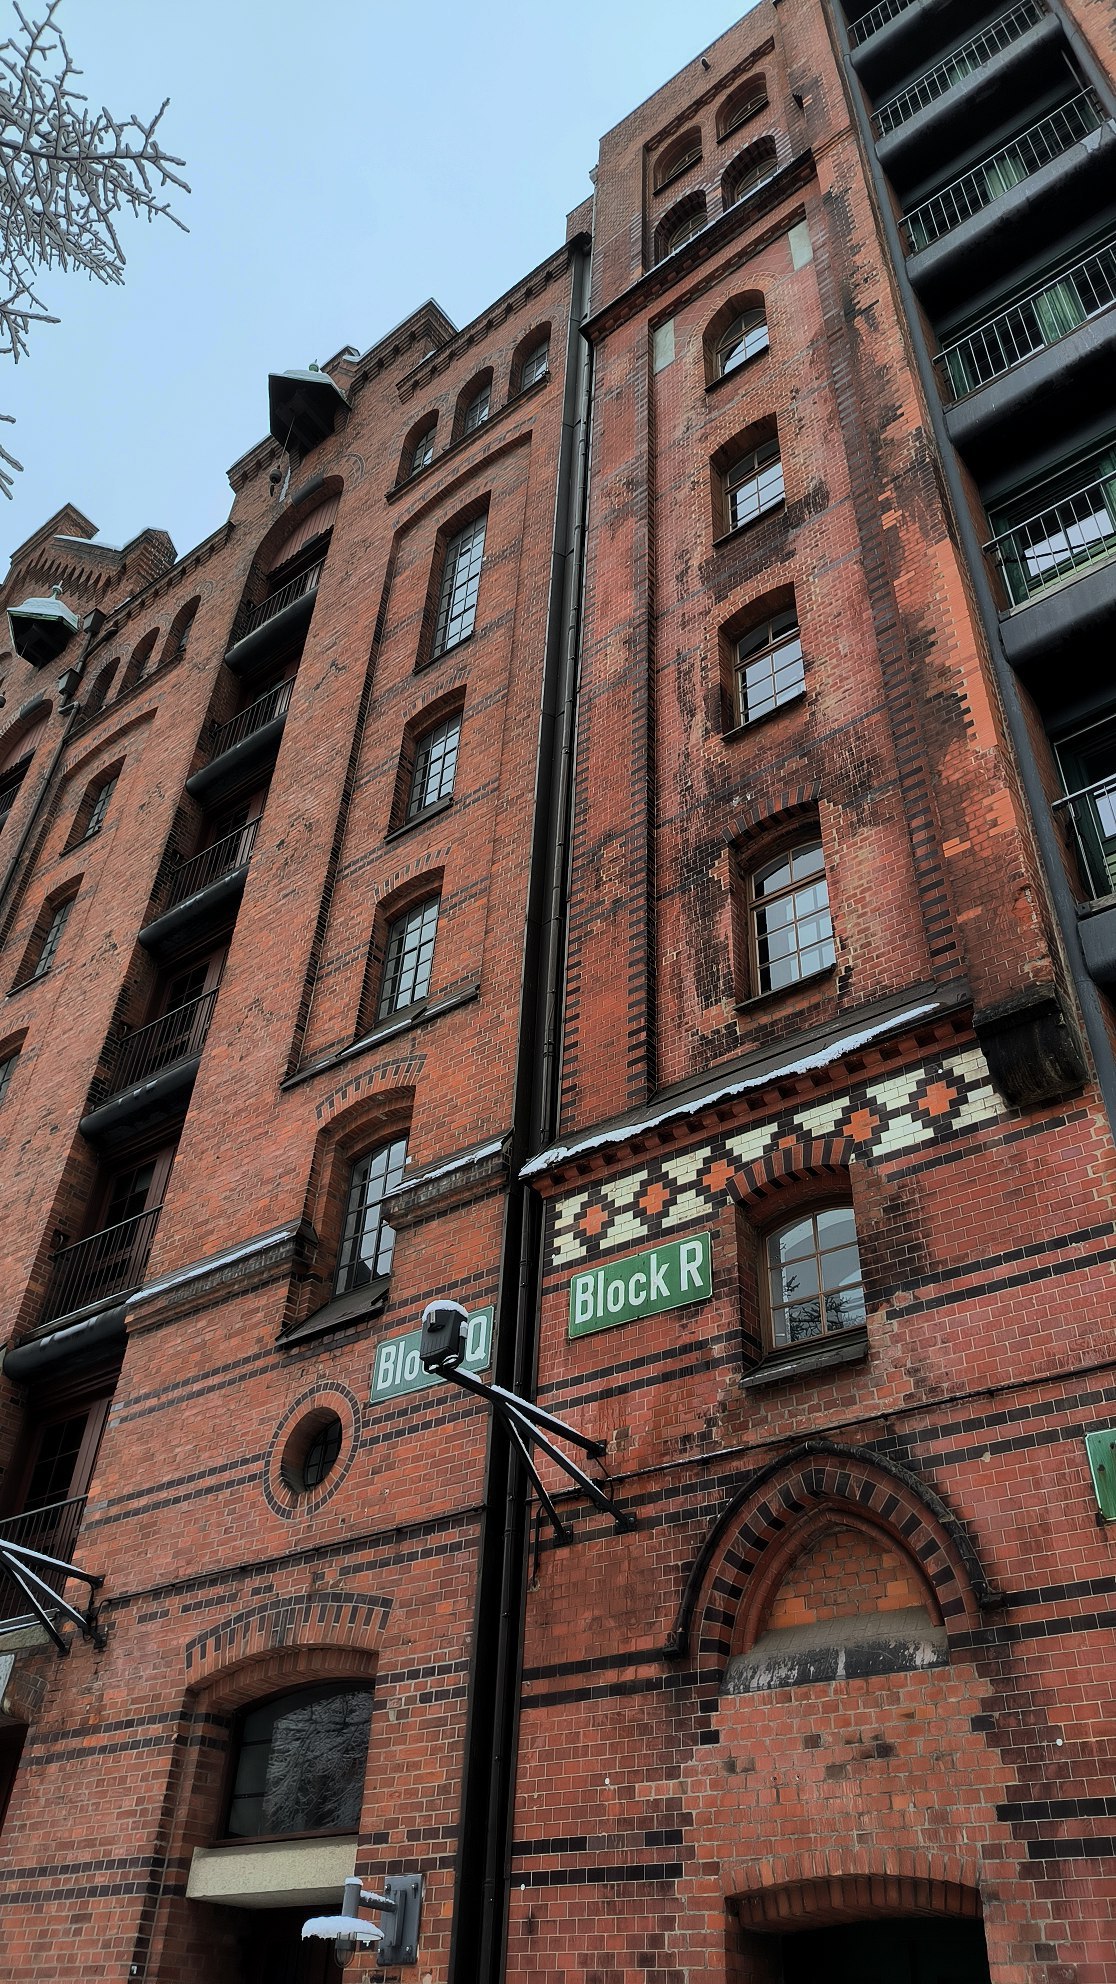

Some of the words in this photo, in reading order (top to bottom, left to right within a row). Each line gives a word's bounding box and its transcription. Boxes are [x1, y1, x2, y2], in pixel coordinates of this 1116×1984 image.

[574, 1252, 671, 1324] Block
[679, 1240, 704, 1292] R
[376, 1340, 431, 1391] Blo
[465, 1315, 488, 1362] Q
